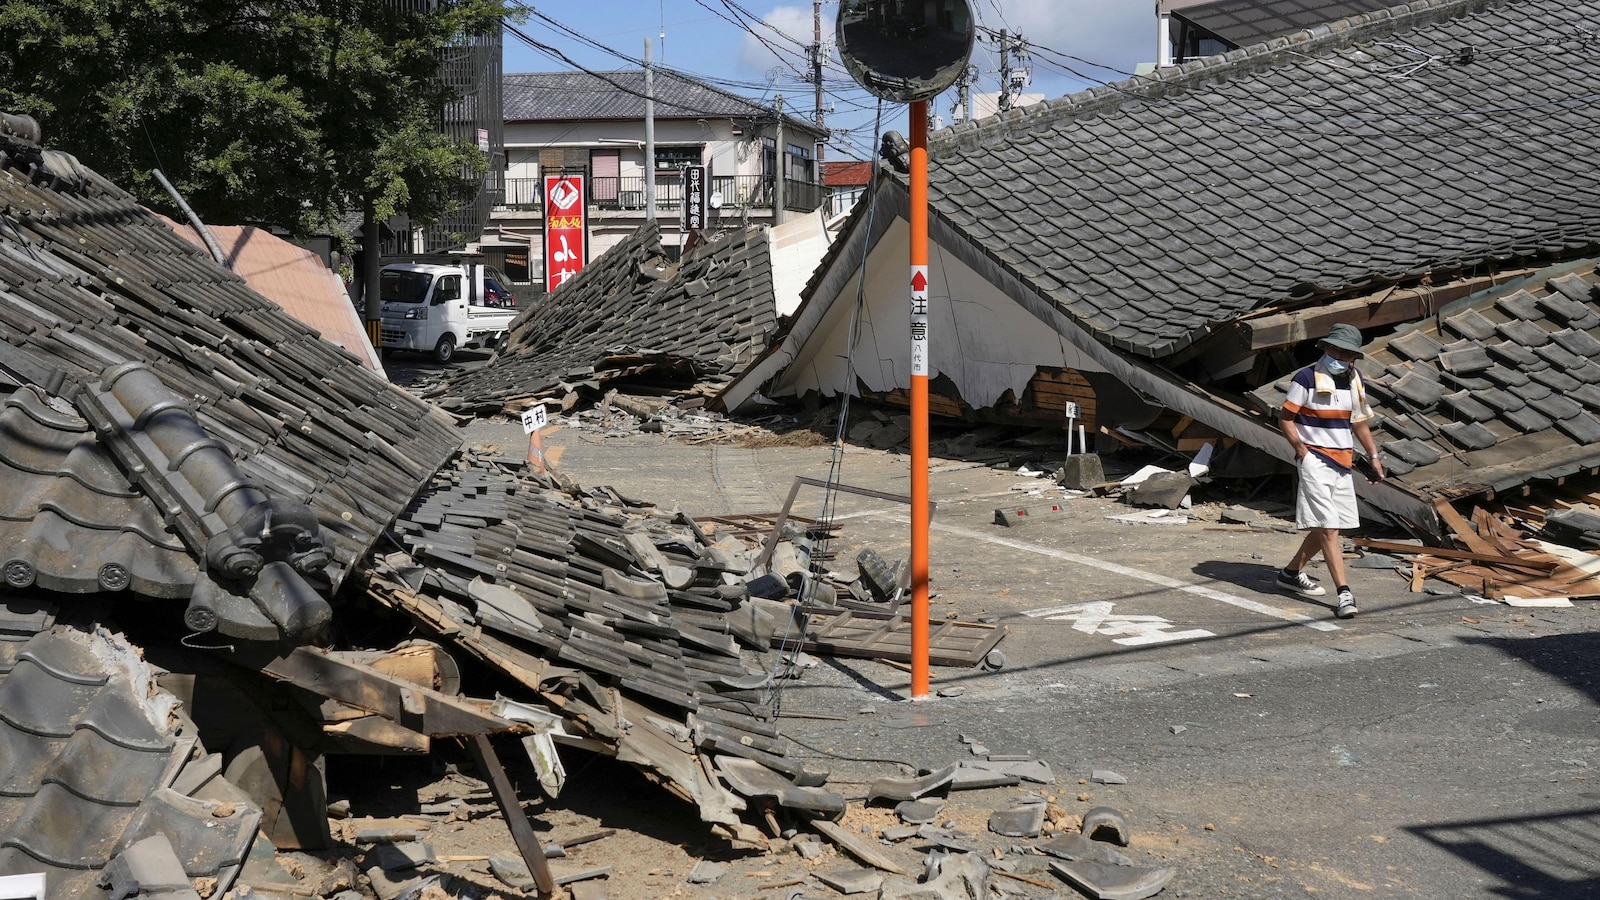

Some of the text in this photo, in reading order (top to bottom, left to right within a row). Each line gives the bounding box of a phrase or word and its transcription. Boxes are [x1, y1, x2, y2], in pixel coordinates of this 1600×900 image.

[910, 296, 927, 341] 注意
[913, 344, 922, 372] 八代市
[524, 408, 545, 429] 中村
